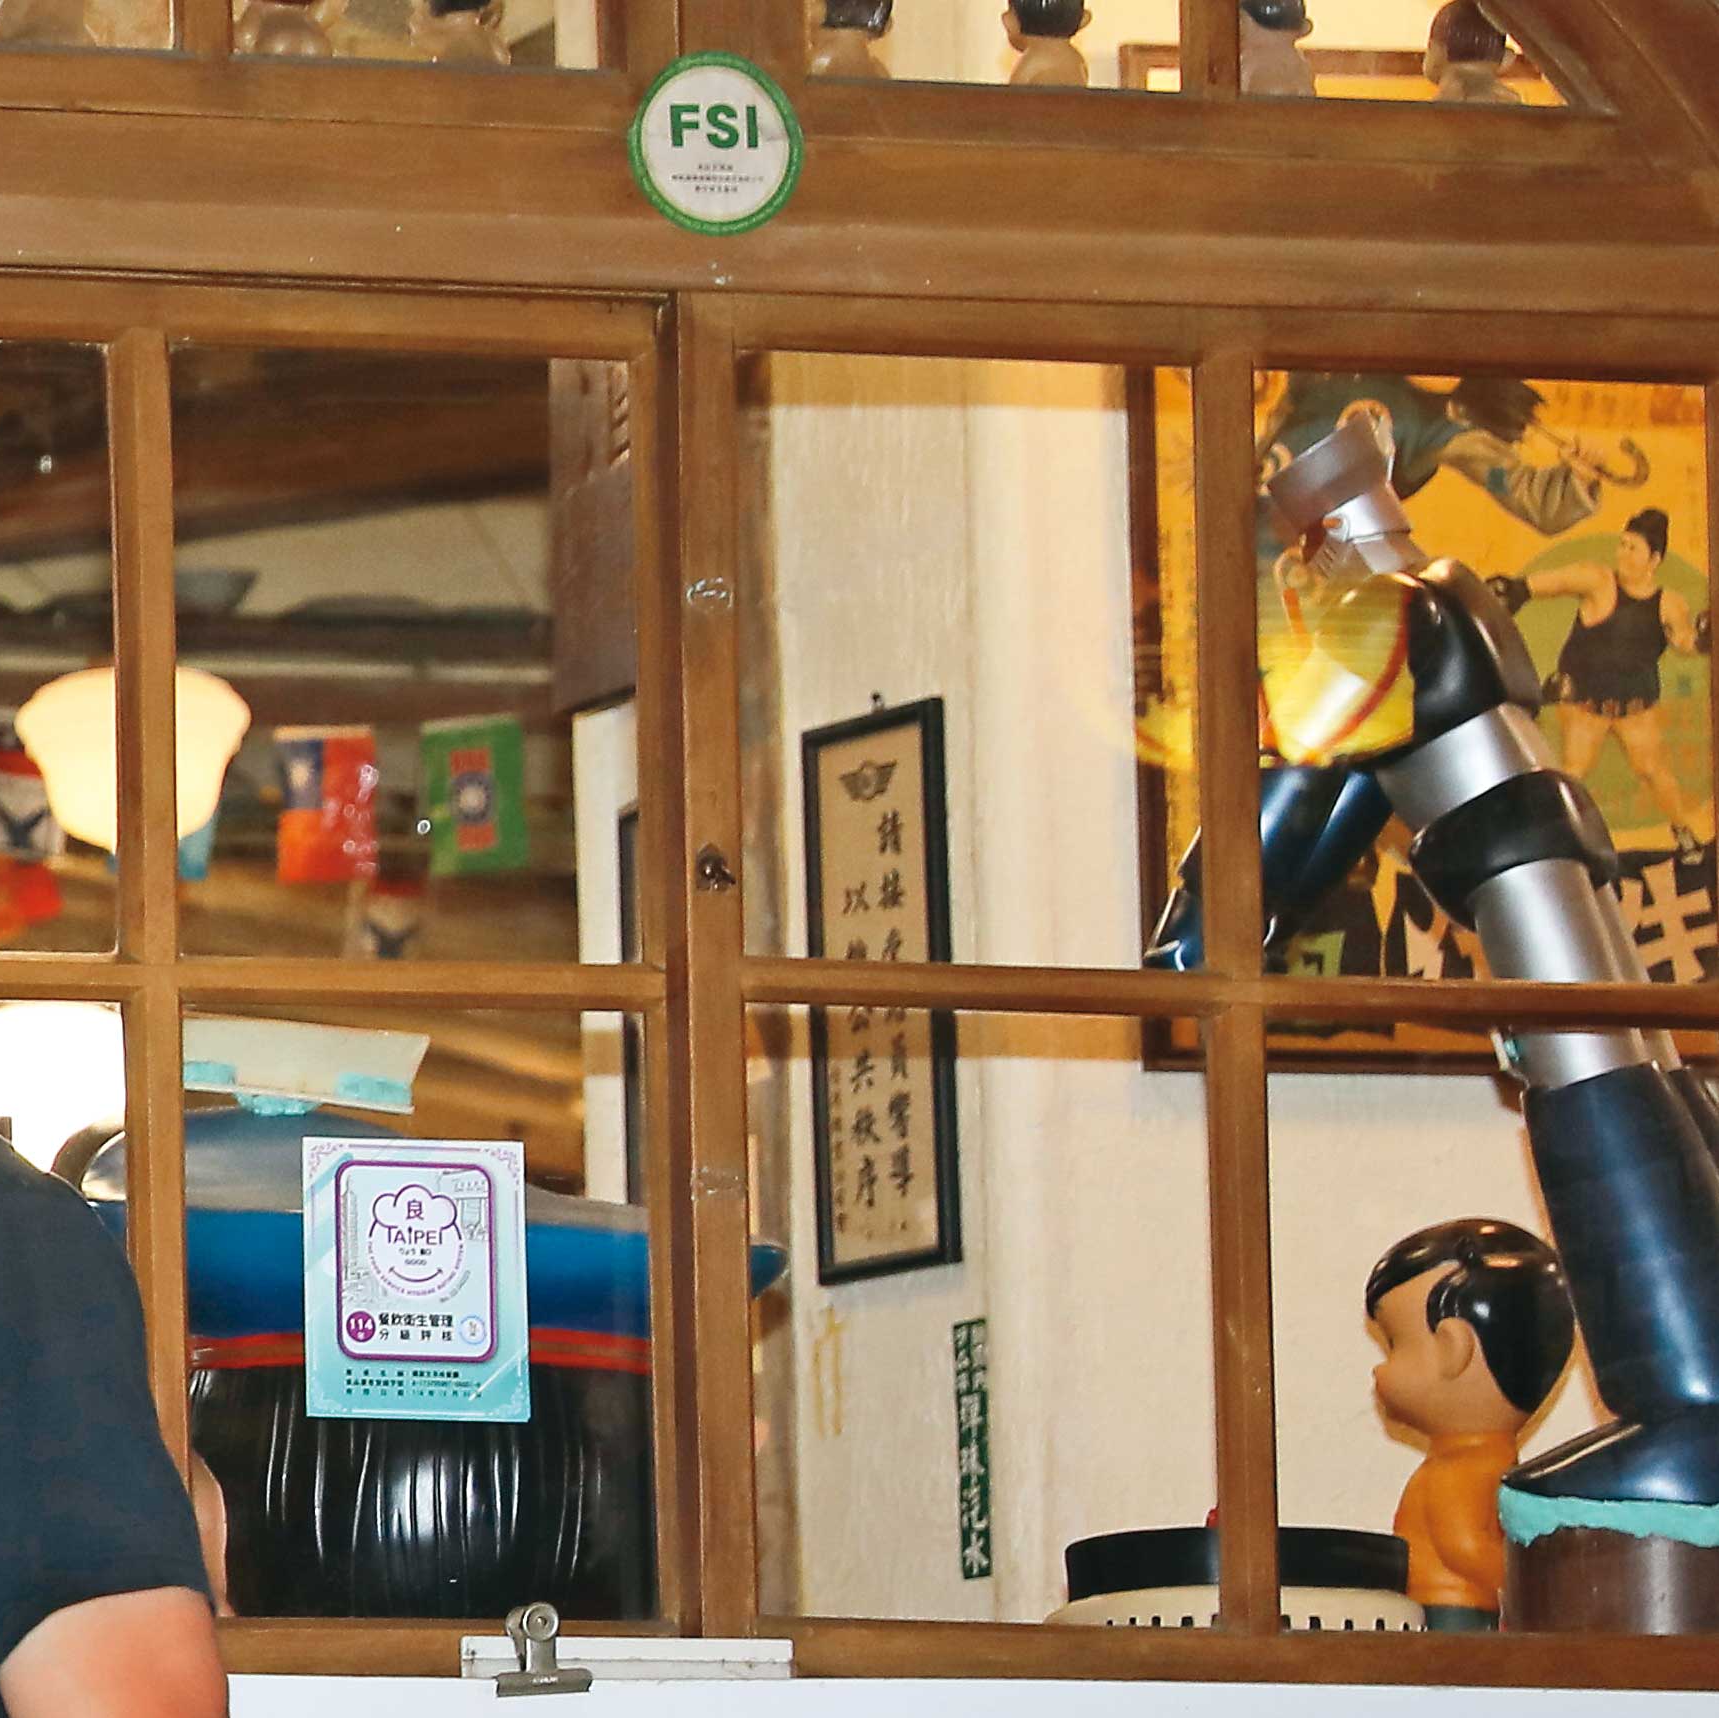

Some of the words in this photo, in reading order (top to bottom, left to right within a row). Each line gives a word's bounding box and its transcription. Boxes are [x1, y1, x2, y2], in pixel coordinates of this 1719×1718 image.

[670, 104, 758, 149] FSI
[406, 1199, 425, 1221] 良
[387, 1225, 444, 1246] TAIPEI
[350, 1317, 373, 1331] 114
[379, 1314, 453, 1328] 餐飲衛生管理
